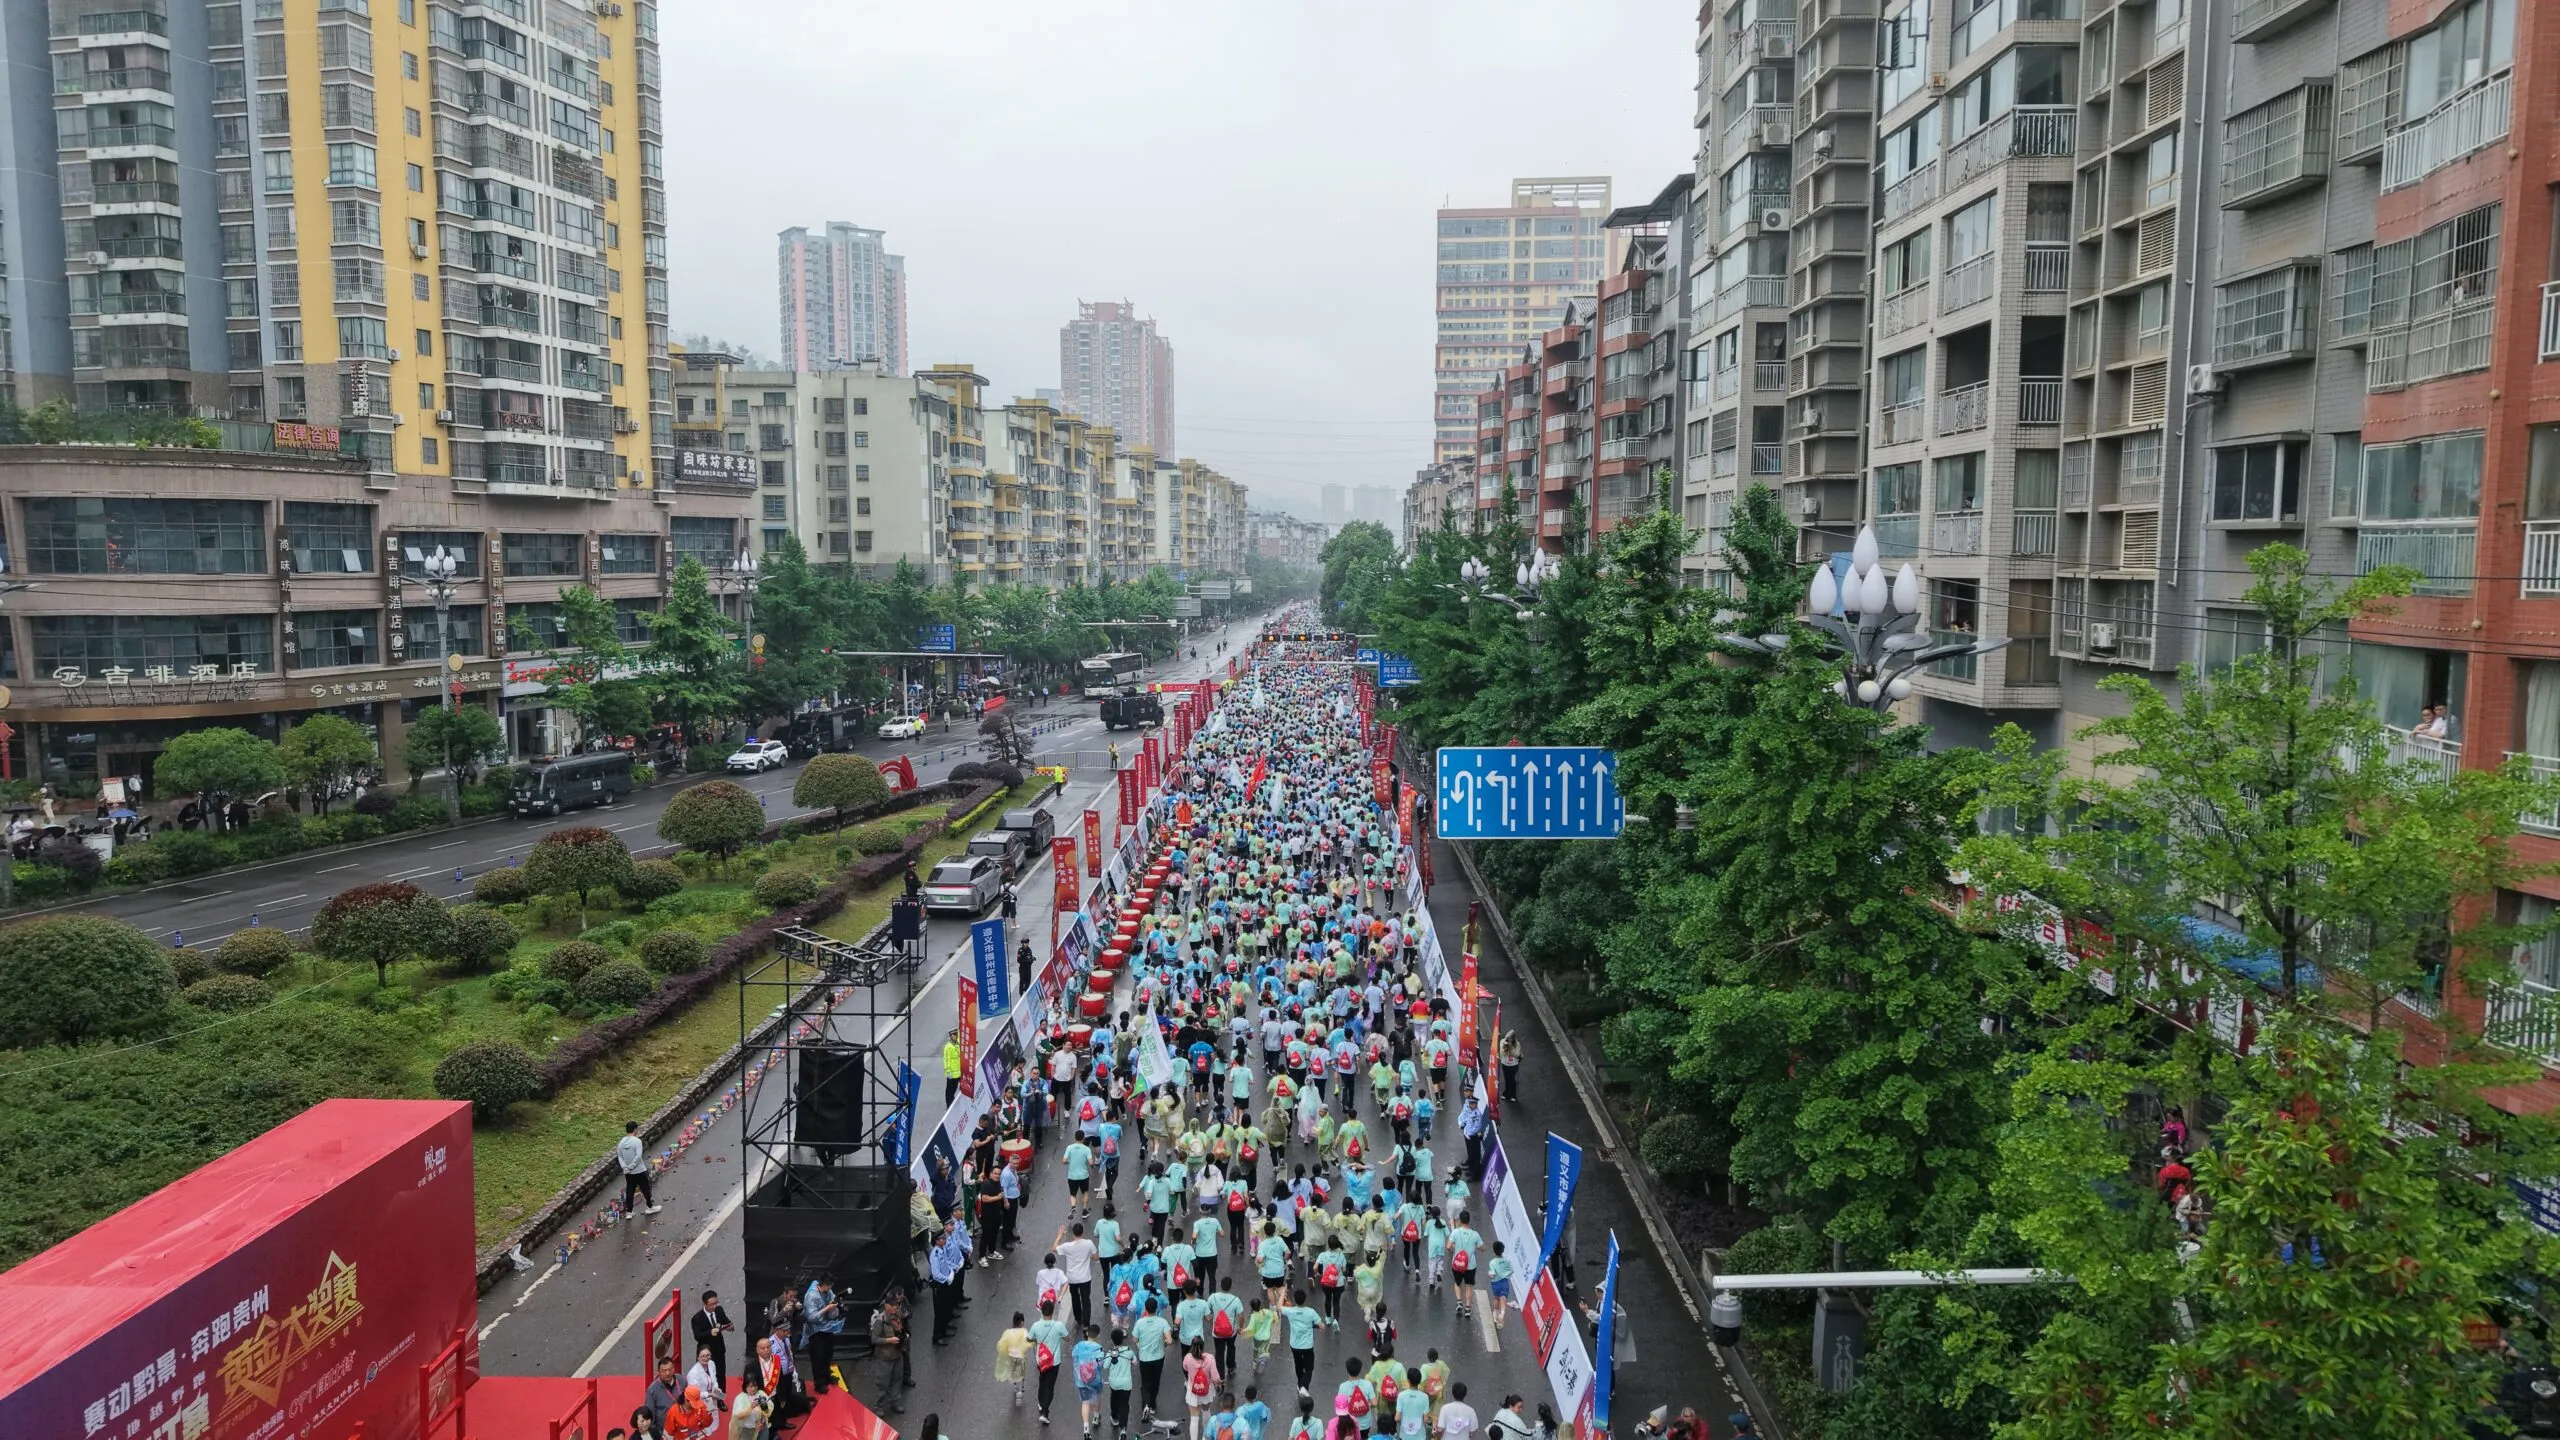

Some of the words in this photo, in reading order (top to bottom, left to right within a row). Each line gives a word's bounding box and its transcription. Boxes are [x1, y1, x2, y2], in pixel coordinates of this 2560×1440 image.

[277, 424, 340, 444] 法律咨询
[683, 451, 756, 473] 尚味坊家宴馆
[279, 538, 296, 654] 尚味坊家宴馆
[386, 556, 403, 629] 吉啡酒店
[491, 558, 505, 625] 吉啡酒店
[101, 661, 258, 685] 吉啡酒店
[330, 680, 388, 695] 吉啡酒店
[215, 1250, 360, 1408] 黄金大奖赛
